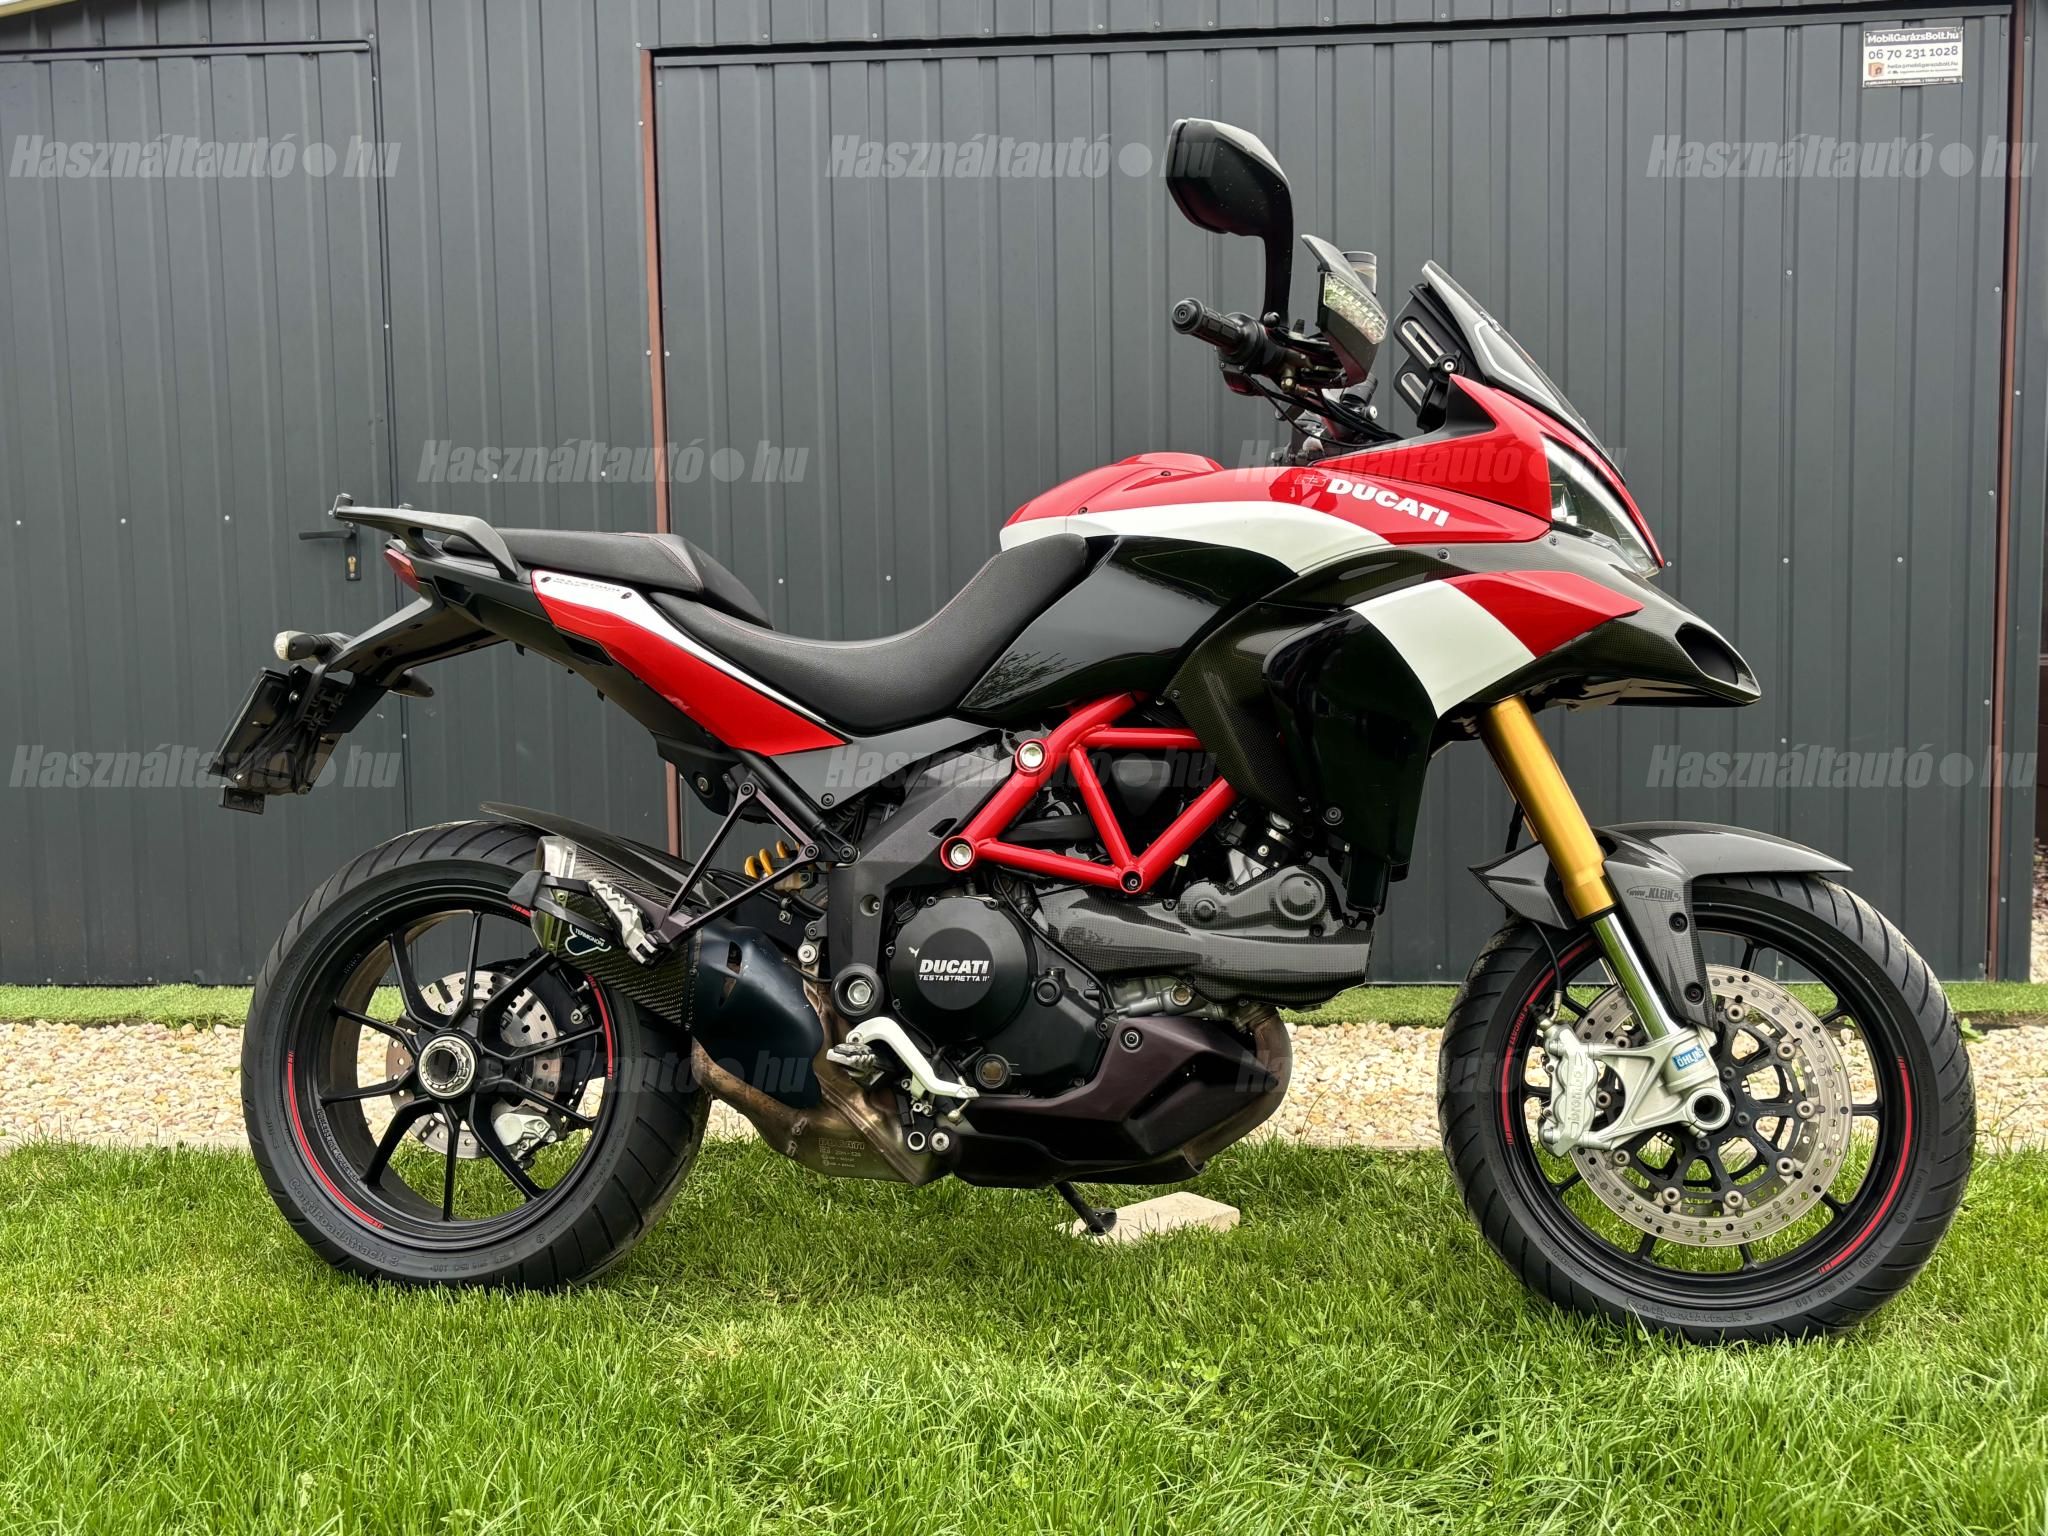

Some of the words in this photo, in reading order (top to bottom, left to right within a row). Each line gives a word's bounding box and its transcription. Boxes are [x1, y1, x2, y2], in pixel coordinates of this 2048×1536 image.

[1867, 31, 1959, 44] MobilGarázsBolt.hu
[1868, 50, 1884, 60] 06
[1887, 49, 1902, 61] 70
[1905, 48, 1926, 59] 231
[1929, 45, 1959, 57] 1028
[1326, 478, 1450, 528] DUCATI
[919, 959, 990, 974] DUCATI
[919, 974, 981, 982] TESTASTRETTA
[1568, 1070, 1585, 1125] brembo
[289, 1177, 386, 1264] ContiRoadAttack
